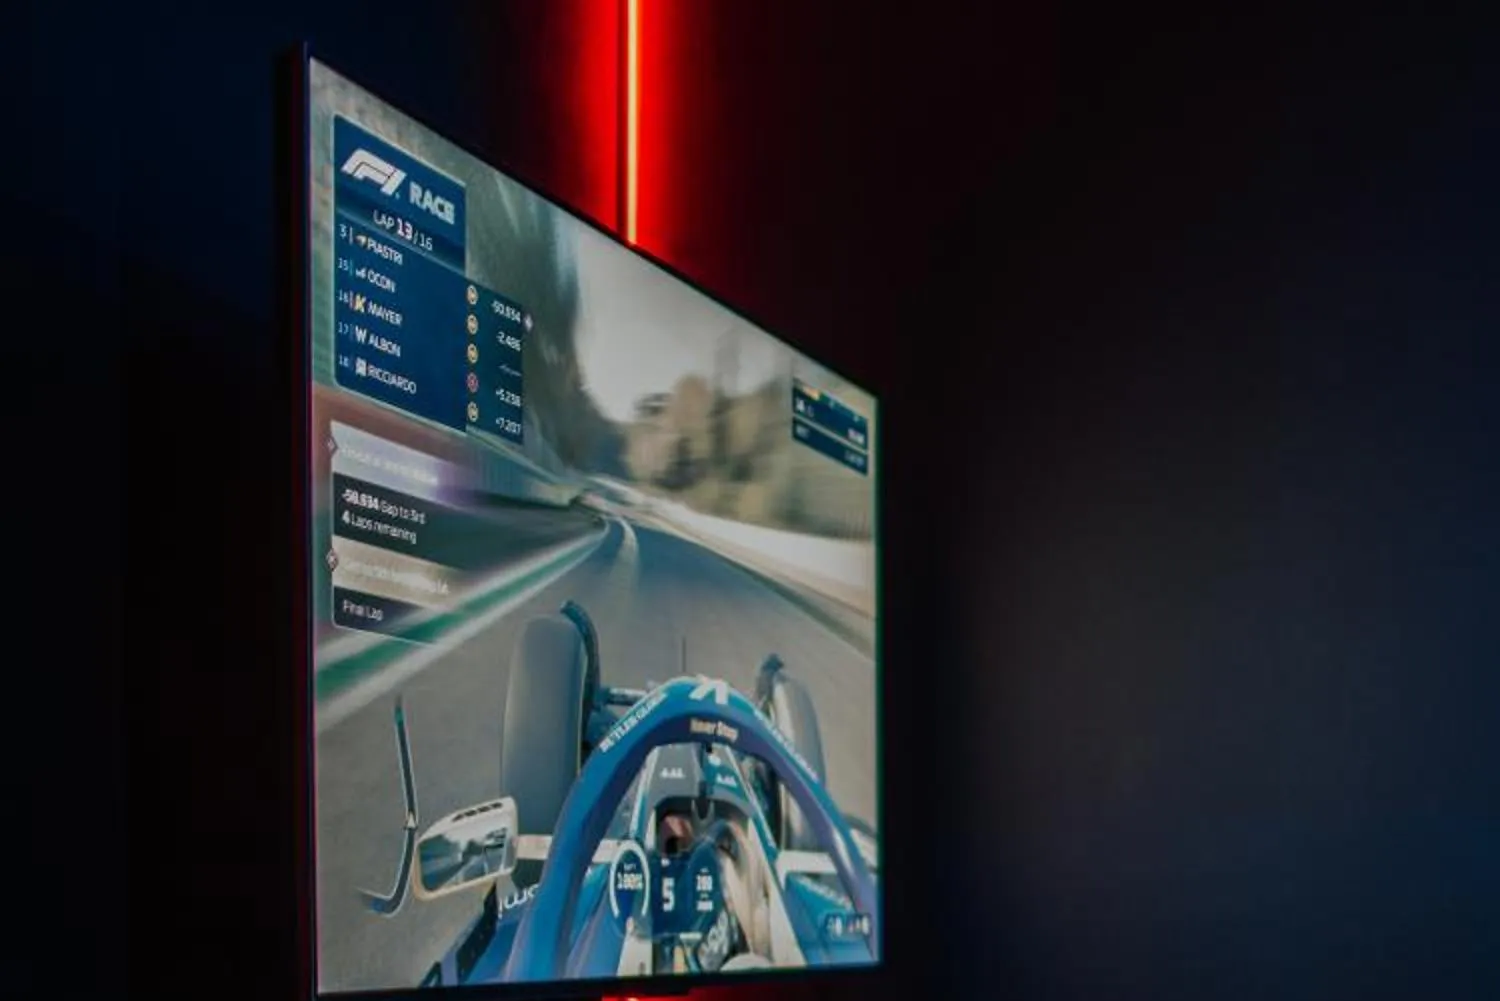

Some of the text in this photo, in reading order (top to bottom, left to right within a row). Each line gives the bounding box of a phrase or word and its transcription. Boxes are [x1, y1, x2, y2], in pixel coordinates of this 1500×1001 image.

[340, 148, 455, 225] F1 RACE
[373, 209, 395, 230] LAP
[367, 237, 403, 265] PIASTRI
[367, 269, 396, 293] OCON
[368, 301, 402, 326] MAYER
[369, 333, 401, 357] ALBON
[367, 363, 417, 394] RICCIARDO
[373, 520, 417, 544] remaining
[662, 877, 676, 912] 5
